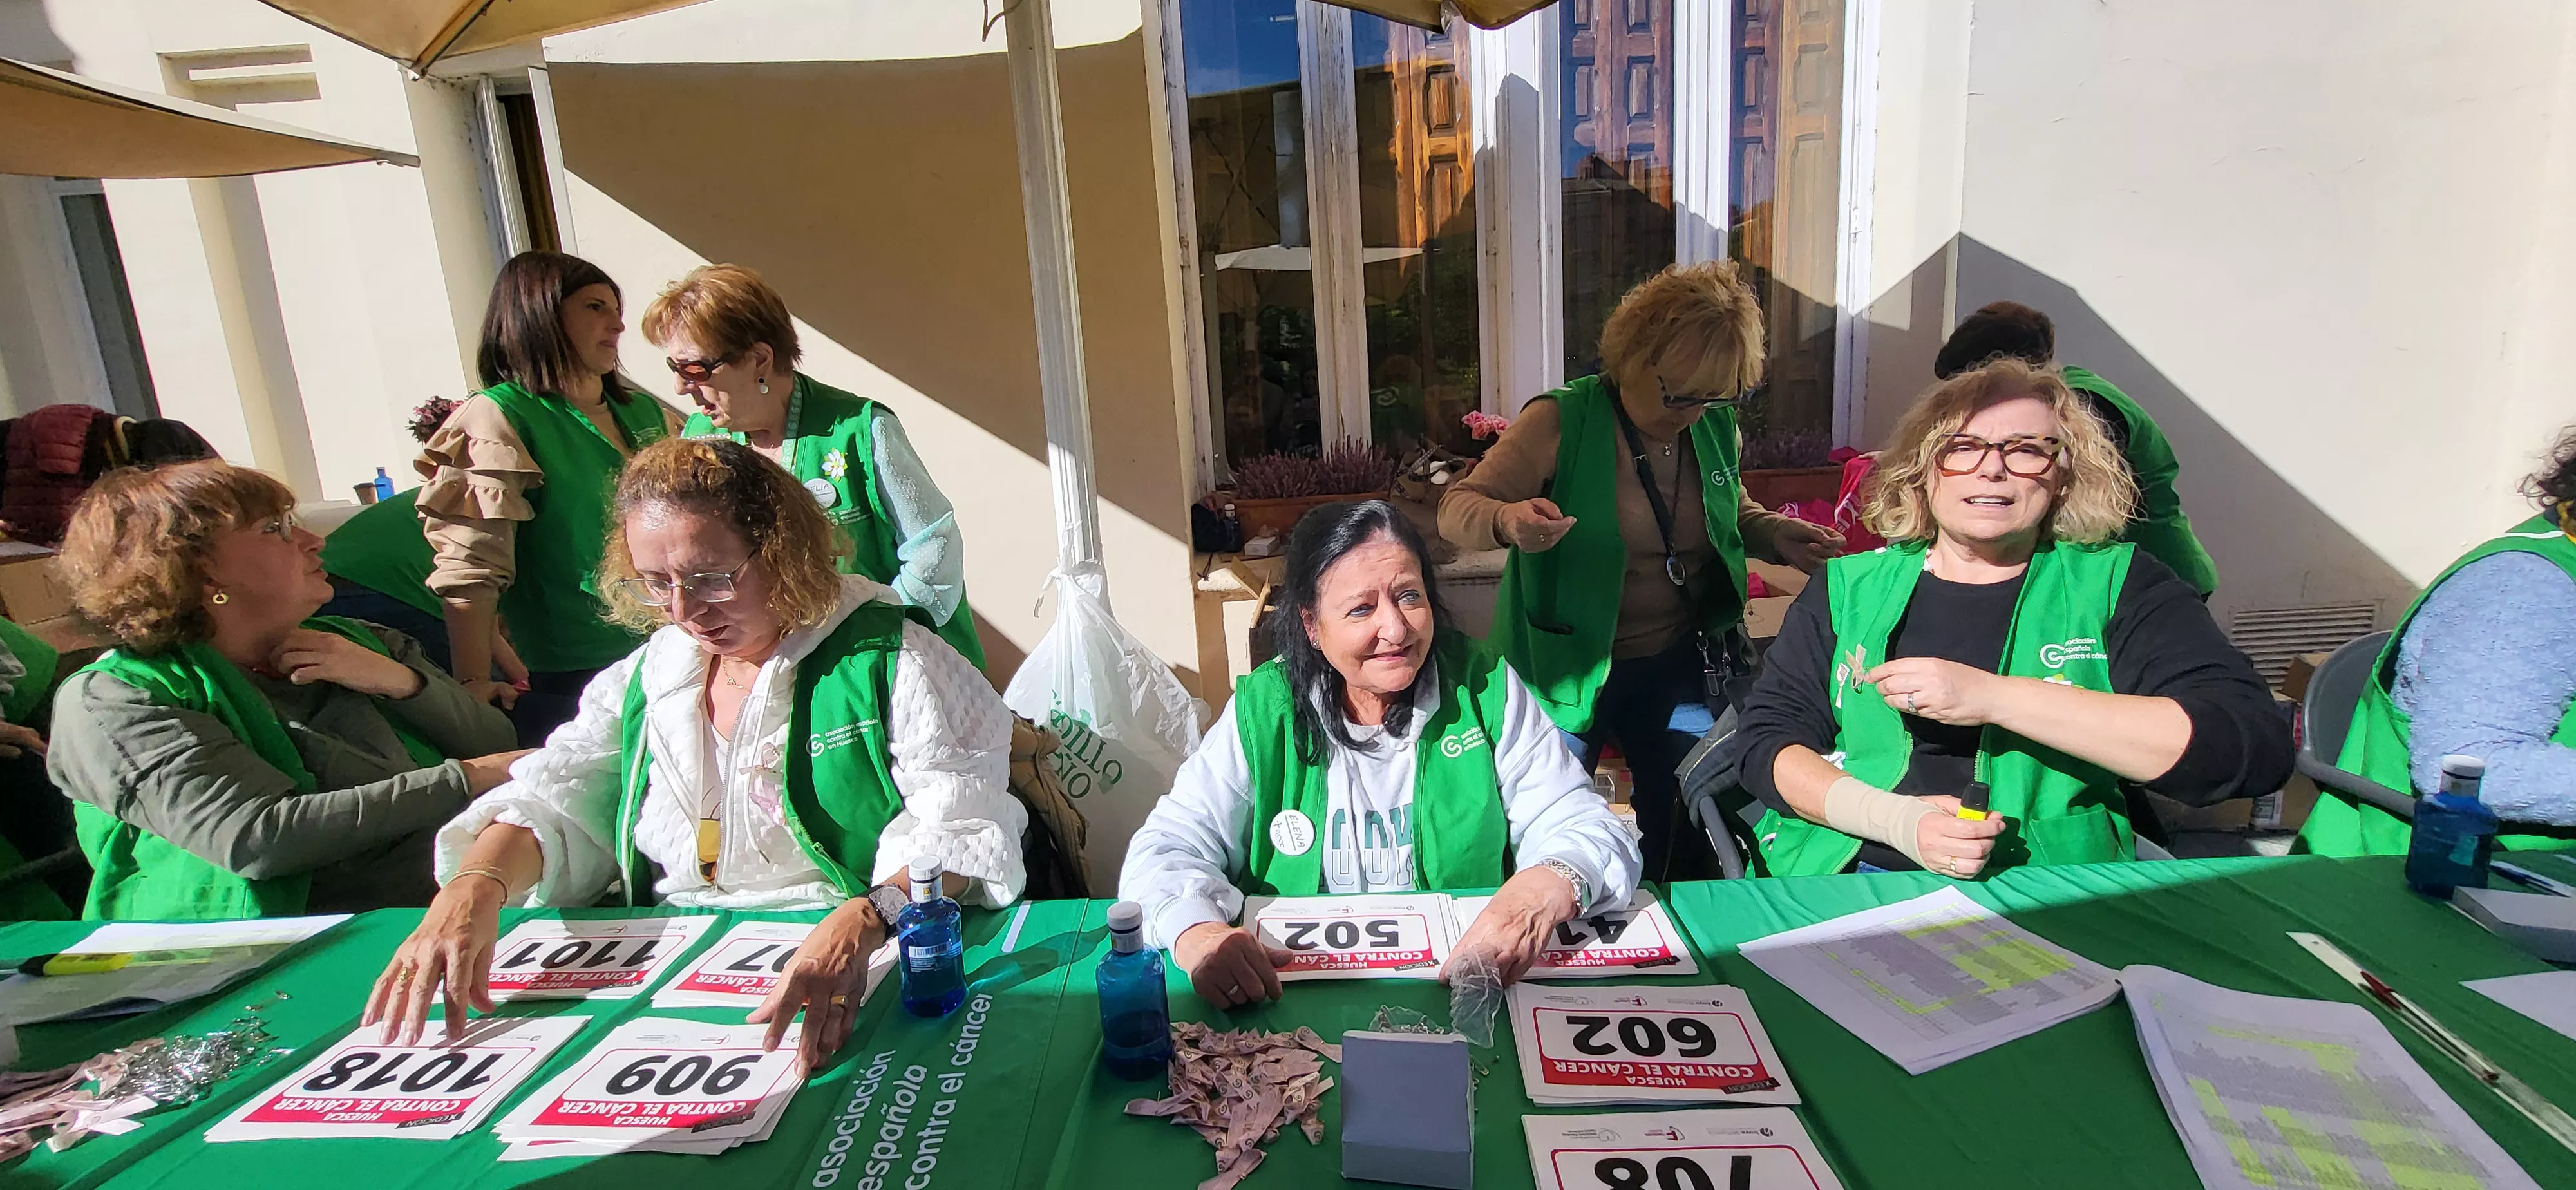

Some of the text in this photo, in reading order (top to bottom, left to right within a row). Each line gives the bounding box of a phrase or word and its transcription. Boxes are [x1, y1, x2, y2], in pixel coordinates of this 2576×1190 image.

[827, 733, 846, 743] contra
[837, 737, 858, 747] Huesca
[1289, 815, 1306, 848] ELENA
[1285, 920, 1399, 950] 502
[1555, 916, 1628, 945] 41
[499, 940, 661, 968] 1101
[1294, 954, 1329, 965] CÁN
[1355, 952, 1423, 961] CONTRA
[1577, 950, 1588, 959] EL
[1589, 949, 1660, 959] CONTRA
[1555, 958, 1605, 967] HUESCA
[489, 970, 639, 984] CONTRA EL CÁNCE
[695, 974, 757, 987] CÁNCER
[1566, 1015, 1718, 1058] 602
[303, 1052, 505, 1093] 1018
[605, 1054, 764, 1096] 909
[1553, 1061, 1754, 1078] CONTRA EL CÁNCER
[1625, 1075, 1687, 1086] HUESCA
[904, 993, 993, 1190] contra el cáncer
[274, 1098, 462, 1113] CONTRA EL CÁNCER
[557, 1100, 747, 1118] CONTRA EL CÁNCER
[323, 1112, 383, 1122] HUESCA
[613, 1115, 672, 1126] HUESCA
[811, 1050, 896, 1187] asociación
[857, 1064, 927, 1190] española
